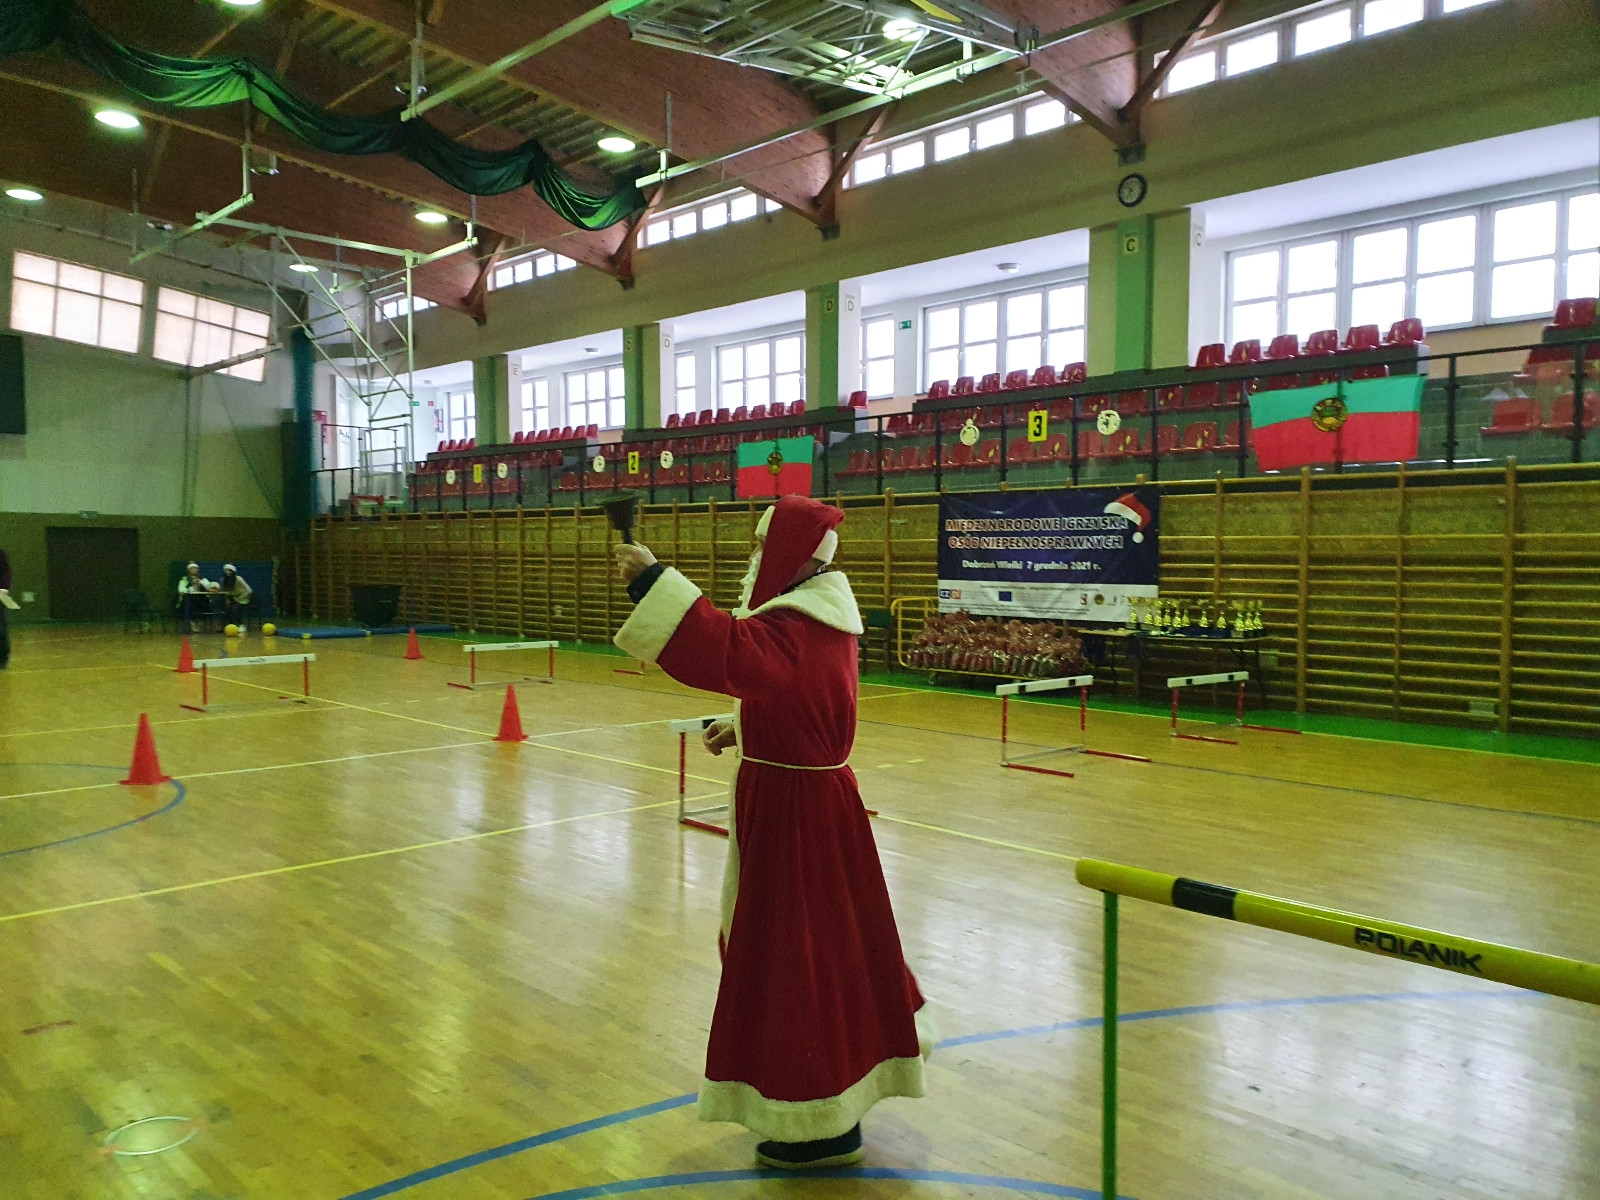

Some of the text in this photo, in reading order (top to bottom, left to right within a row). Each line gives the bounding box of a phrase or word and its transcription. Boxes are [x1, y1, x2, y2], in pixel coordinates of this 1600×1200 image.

[1126, 238, 1136, 252] C
[1033, 415, 1043, 437] 3
[630, 454, 637, 471] 2
[945, 516, 1129, 534] MIĘDZYNARODOWE IGRZYSKA
[948, 533, 1124, 550] OSÓB NIEPEŁNOSPRAWNYCH
[1026, 561, 1033, 570] 7
[1355, 927, 1482, 973] POLANIK
